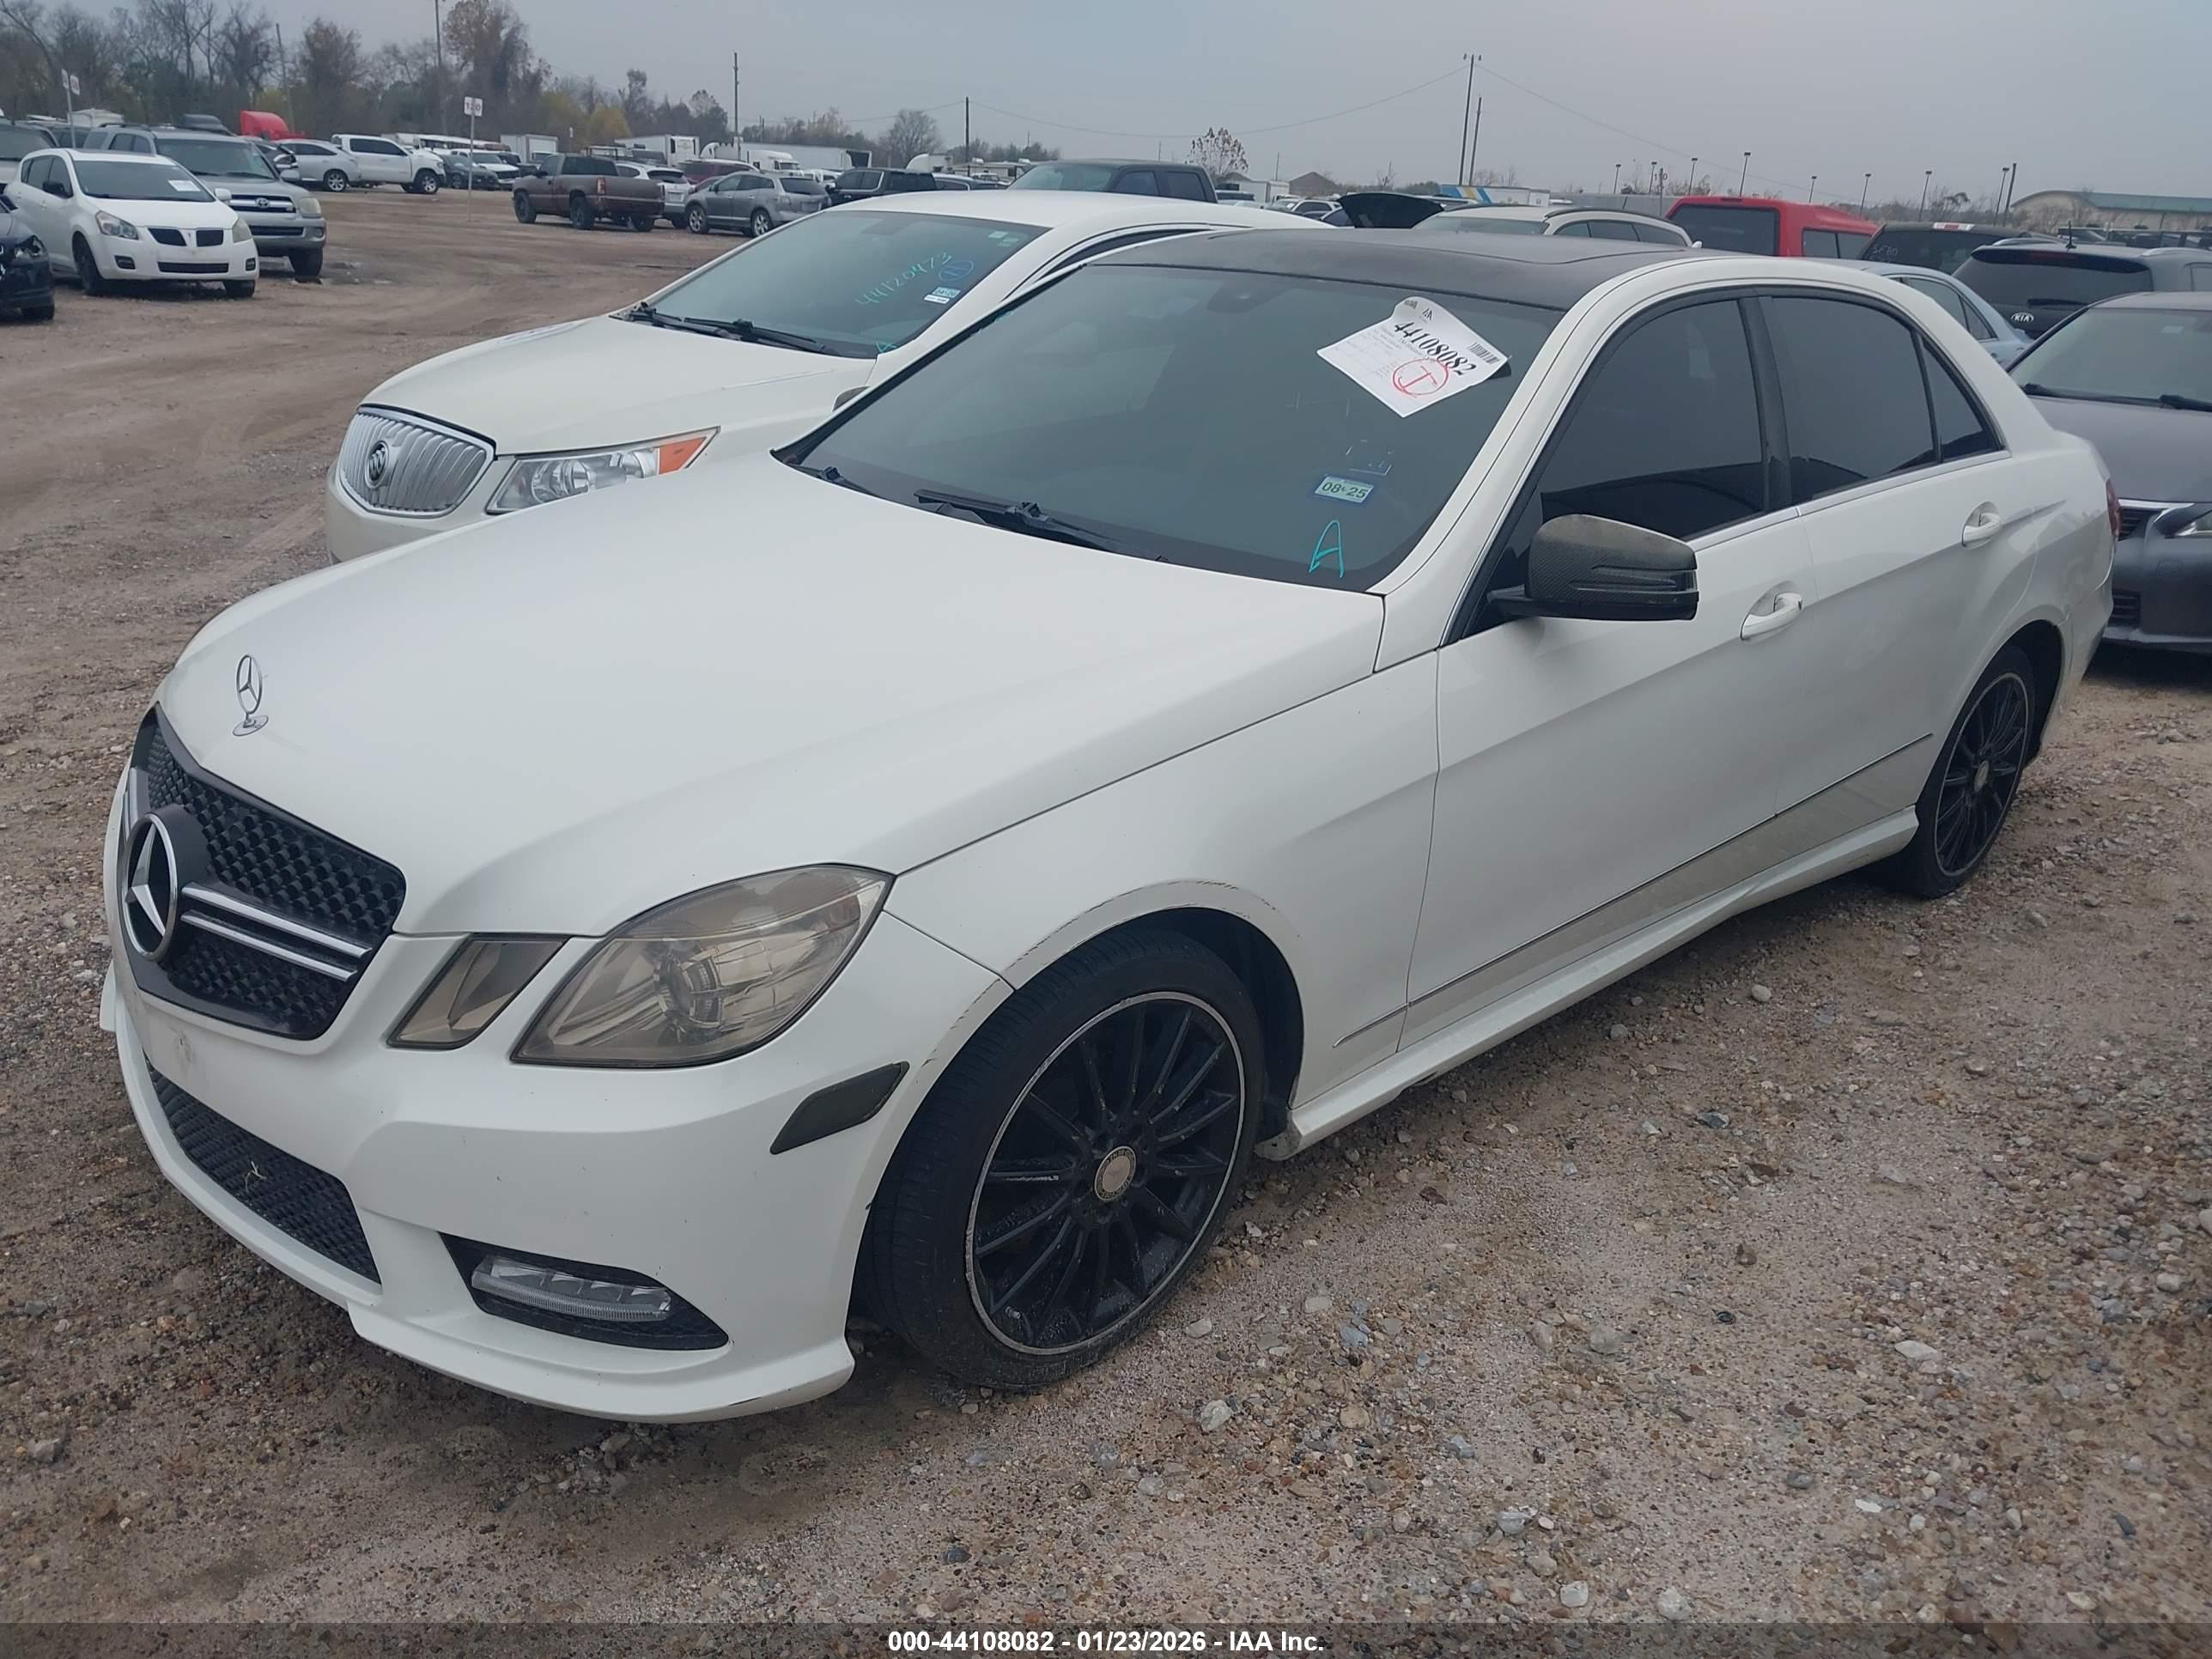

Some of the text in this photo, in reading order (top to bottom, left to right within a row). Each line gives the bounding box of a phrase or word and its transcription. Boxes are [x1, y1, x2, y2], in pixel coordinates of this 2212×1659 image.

[2013, 313, 2032, 323] KIA
[1394, 321, 1478, 376] 44108082
[1322, 481, 1369, 499] 08 25
[1308, 519, 1346, 578] A
